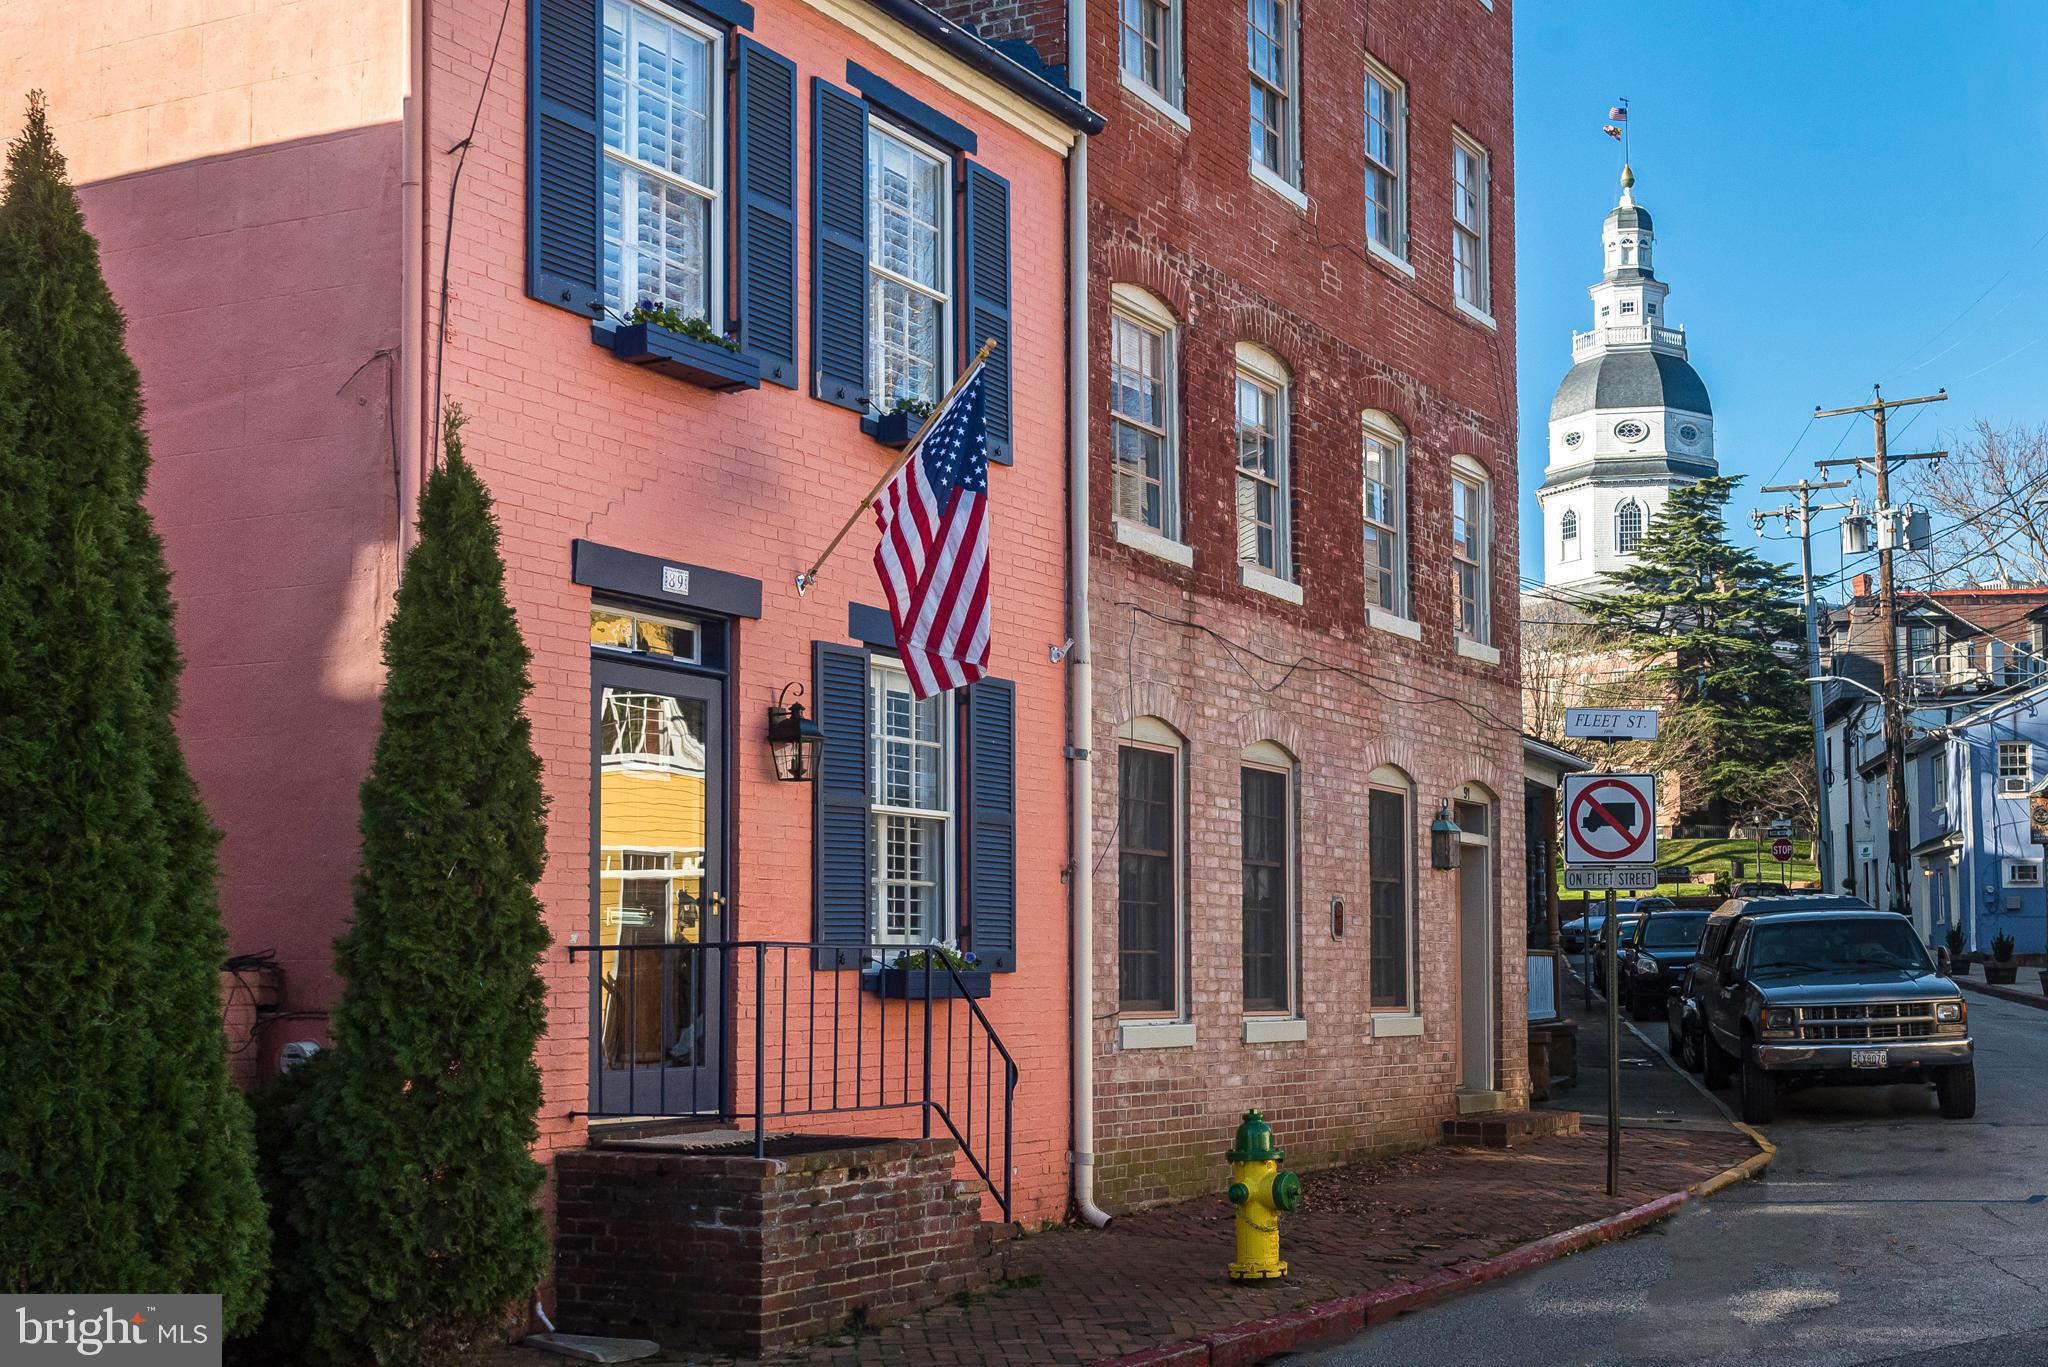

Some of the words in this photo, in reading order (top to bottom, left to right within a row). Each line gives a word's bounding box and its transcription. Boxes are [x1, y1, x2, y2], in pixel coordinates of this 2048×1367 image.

[669, 573, 684, 589] 89
[1575, 713, 1620, 728] FLEET
[1626, 715, 1647, 729] ST.
[1463, 786, 1470, 800] 91
[1773, 845, 1792, 855] STOP
[1569, 872, 1582, 886] ON
[1587, 872, 1614, 886] FLEET
[1618, 872, 1652, 886] STREET
